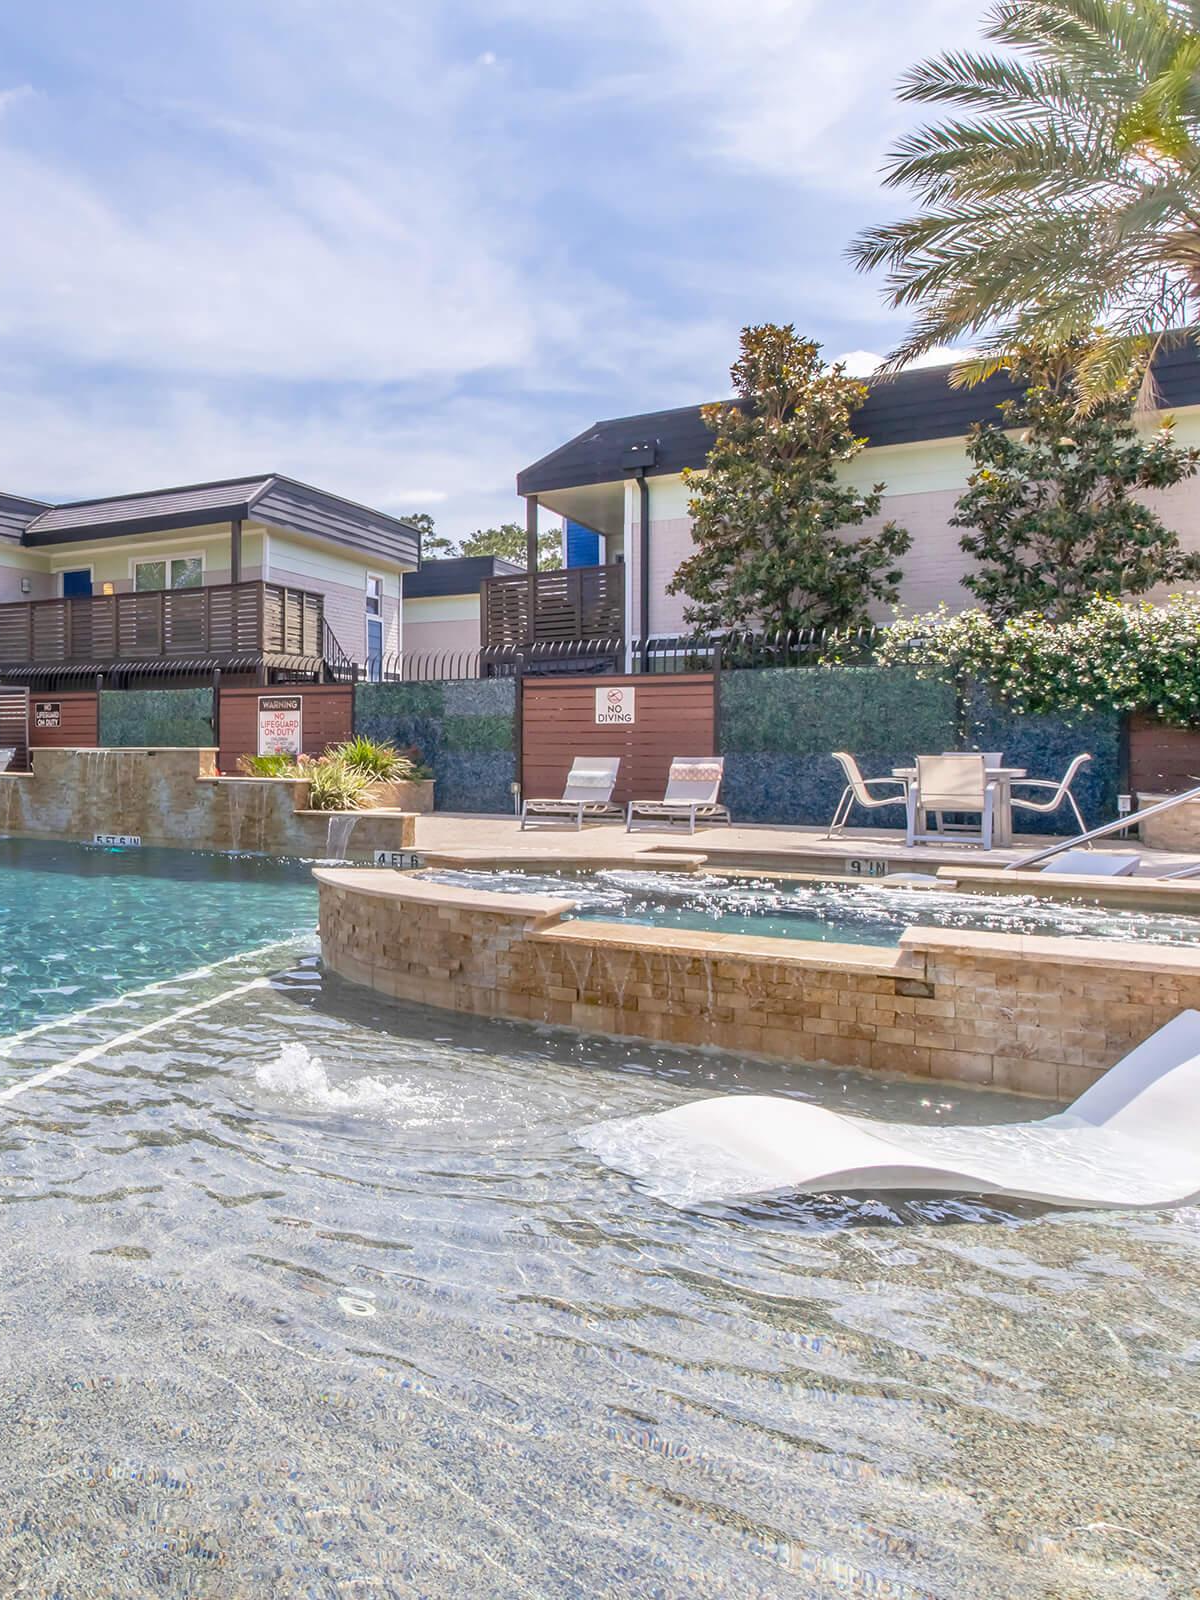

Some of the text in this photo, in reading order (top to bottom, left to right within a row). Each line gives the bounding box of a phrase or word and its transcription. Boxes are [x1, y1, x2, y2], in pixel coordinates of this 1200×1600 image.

[44, 703, 52, 711] NO
[263, 701, 298, 709] WARNING
[608, 705, 622, 713] NO
[598, 714, 632, 722] DIVING
[261, 720, 299, 728] LIFEGUARD
[276, 728, 295, 736] DUTY
[130, 837, 139, 846] IN
[391, 853, 405, 867] FT
[850, 860, 862, 873] 9
